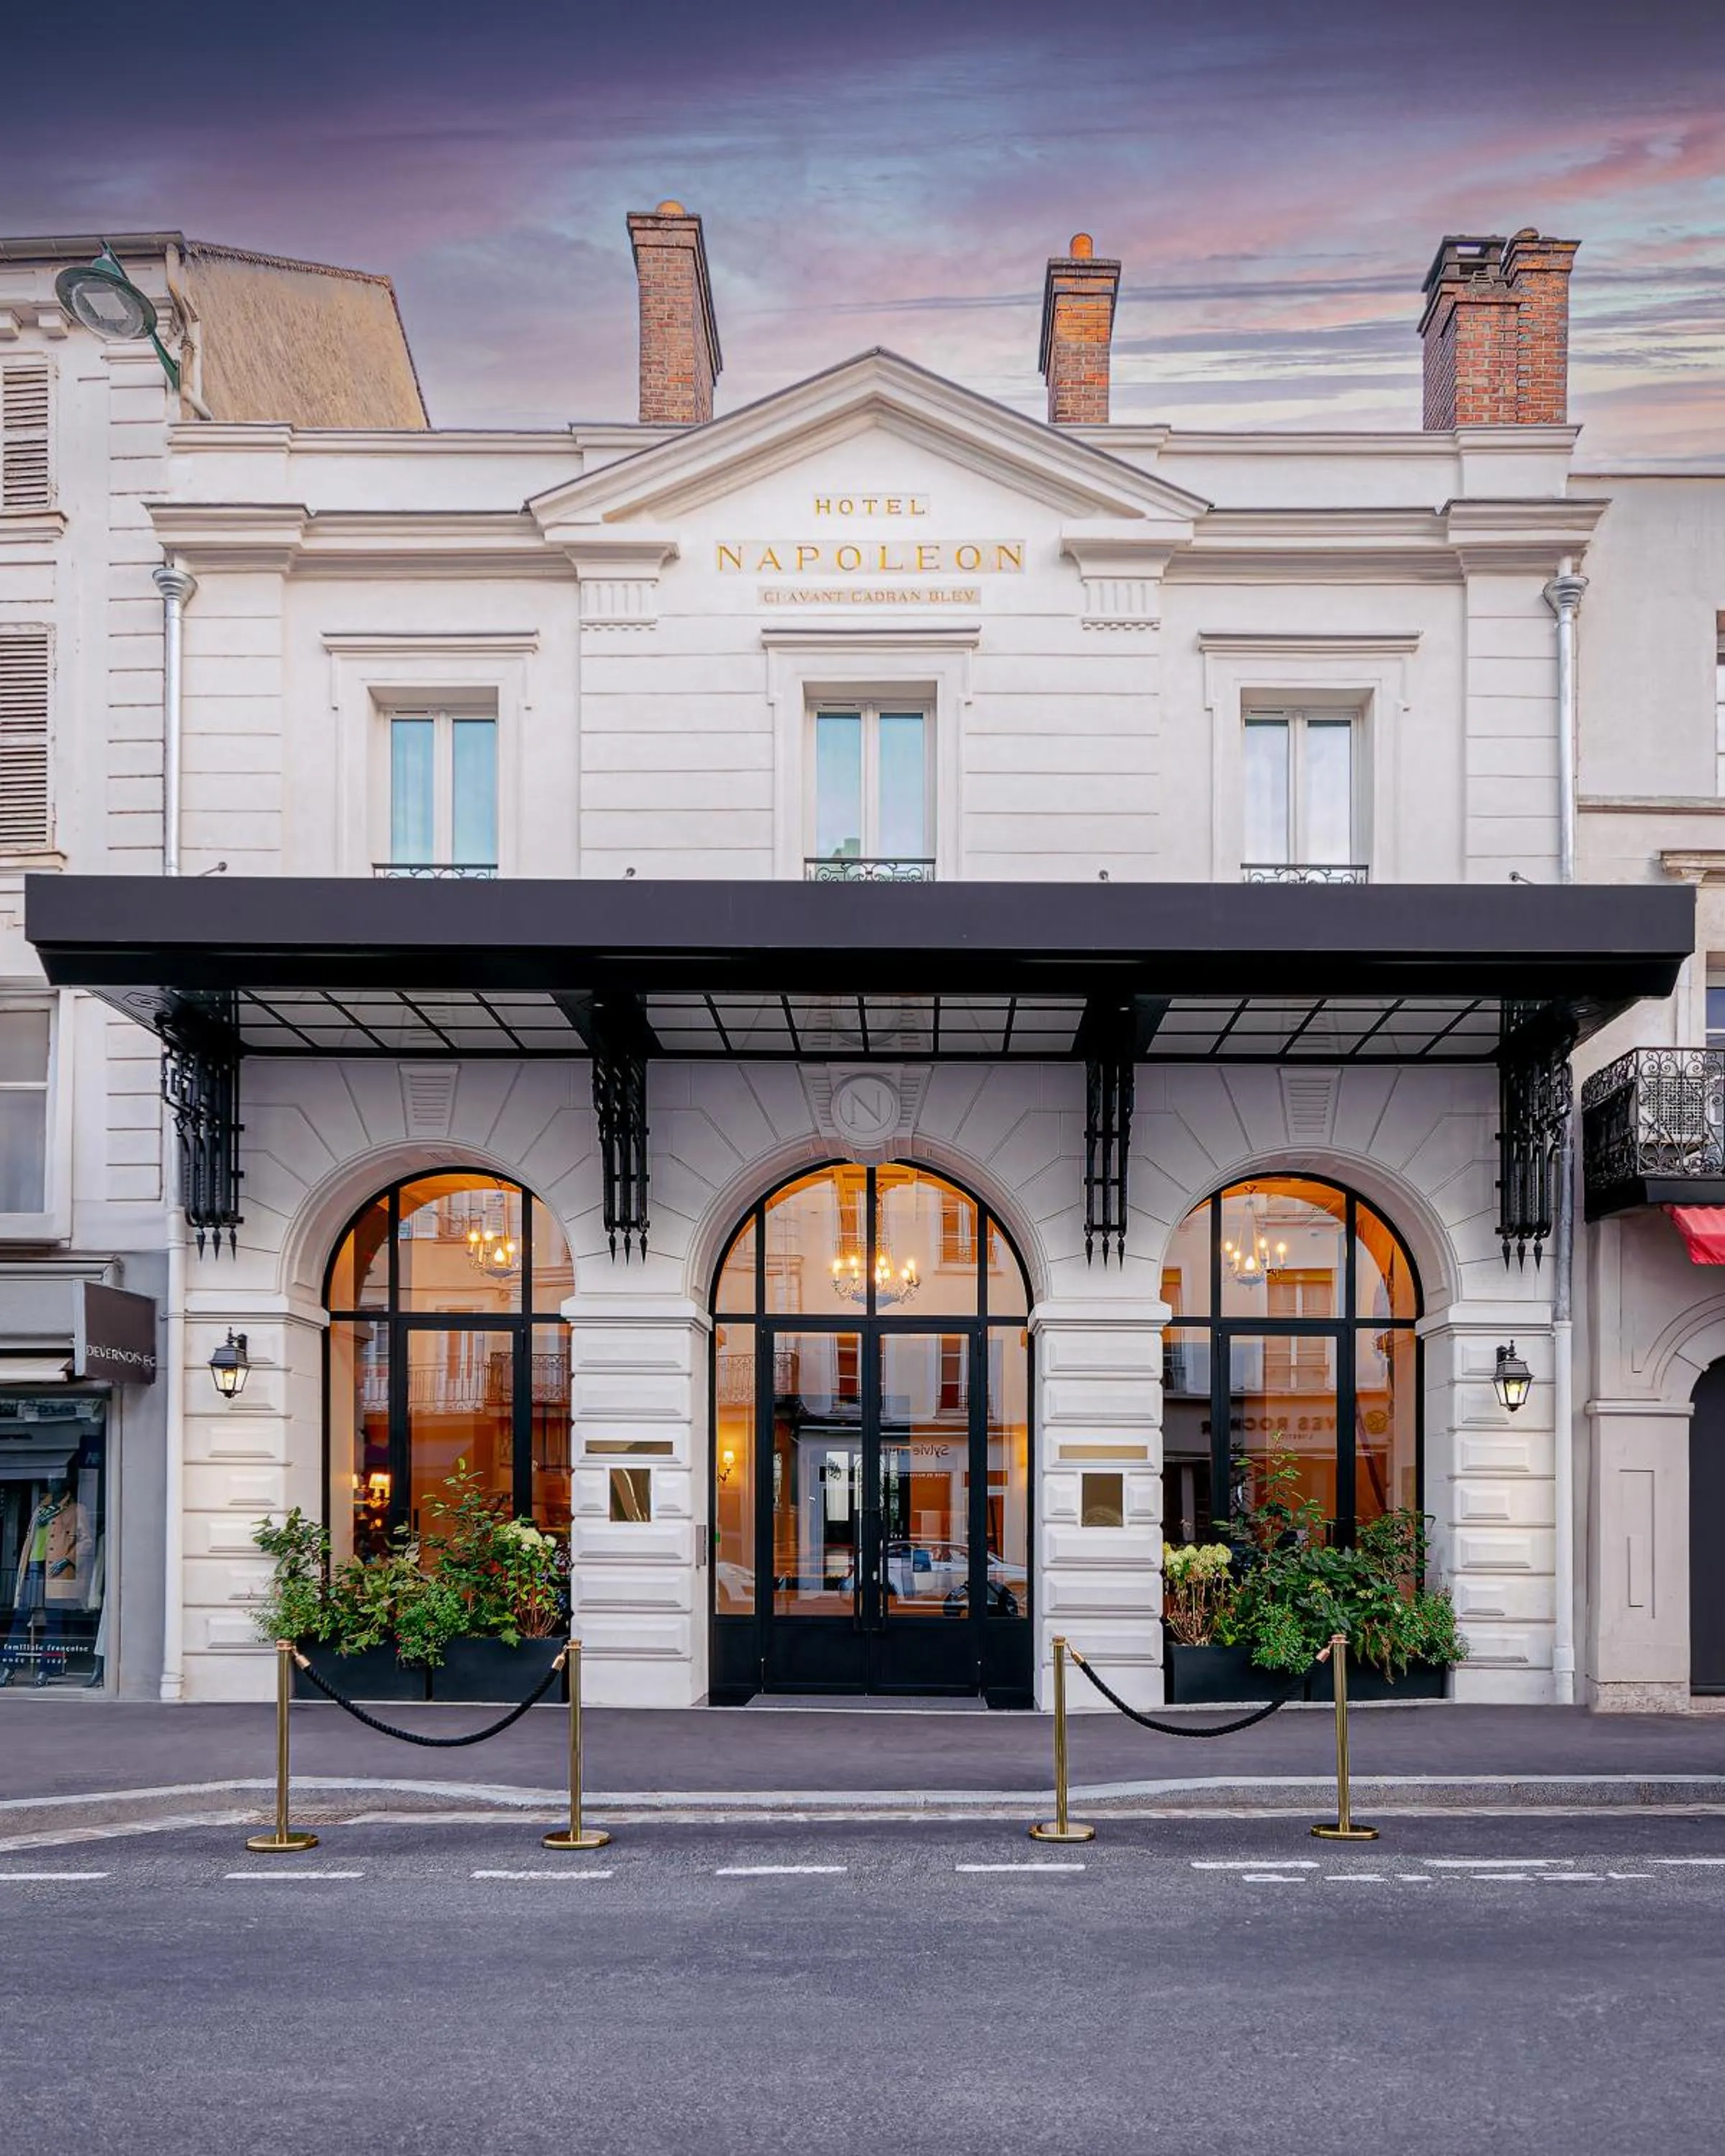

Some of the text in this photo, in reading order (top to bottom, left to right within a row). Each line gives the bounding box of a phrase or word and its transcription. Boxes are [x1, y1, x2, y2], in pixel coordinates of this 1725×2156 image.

[815, 499, 925, 515] HOTEL
[717, 544, 1023, 571] NAPOLEON
[788, 591, 845, 604] AVANT
[851, 590, 921, 603] CADRAN
[847, 1089, 883, 1125] N
